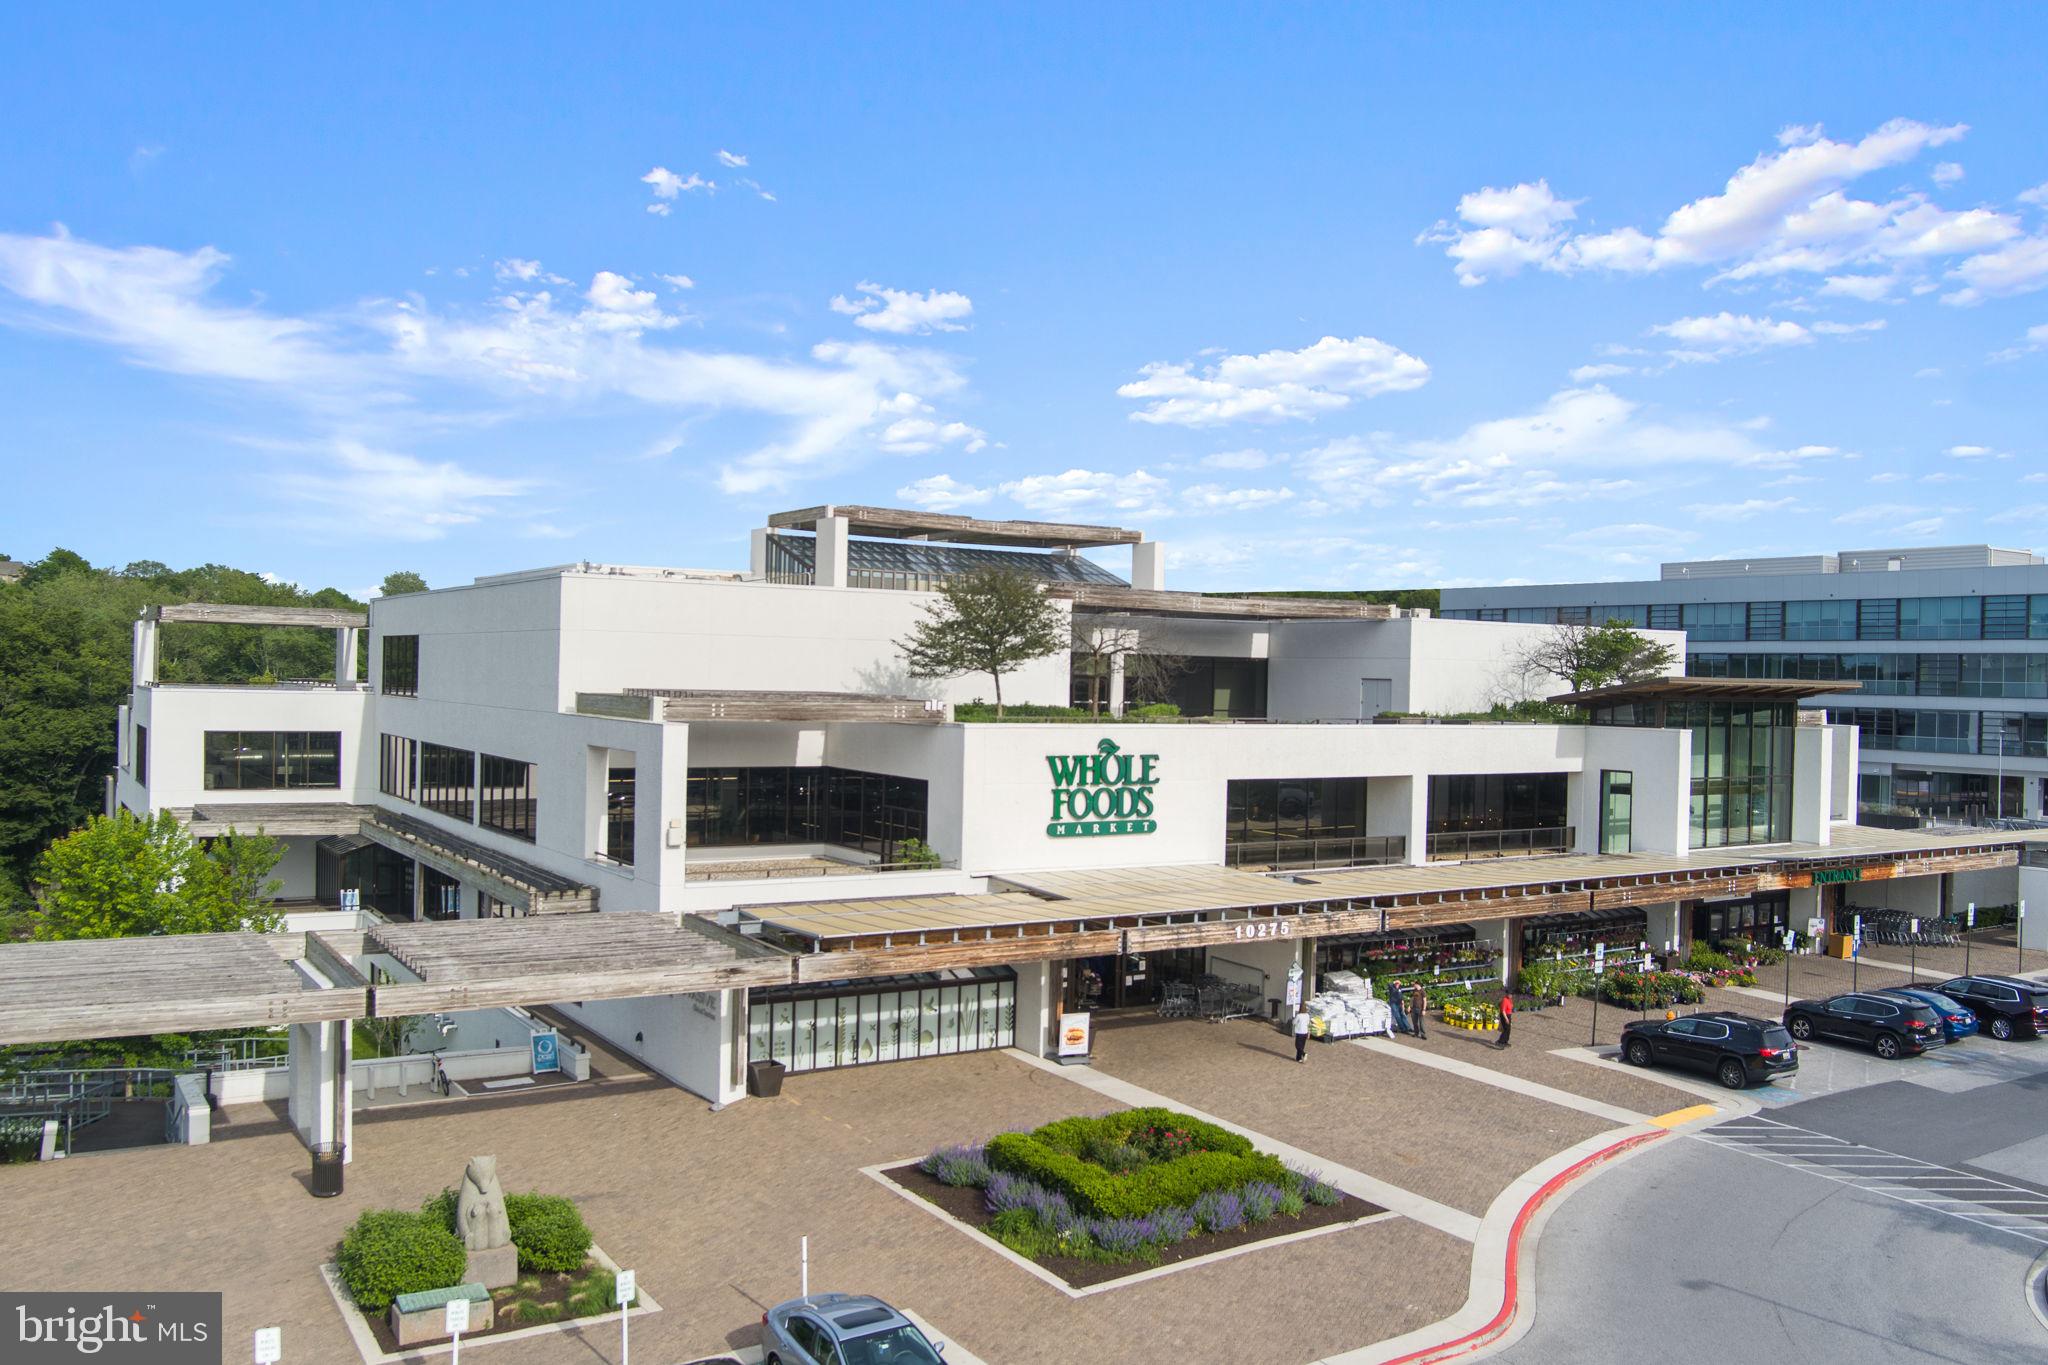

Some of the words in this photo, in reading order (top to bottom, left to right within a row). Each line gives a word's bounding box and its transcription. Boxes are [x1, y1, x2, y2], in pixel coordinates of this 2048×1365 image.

[1046, 748, 1160, 787] WHOLE
[1051, 787, 1154, 820] FOODS
[1056, 822, 1150, 835] MARKET
[1235, 921, 1289, 939] 10275
